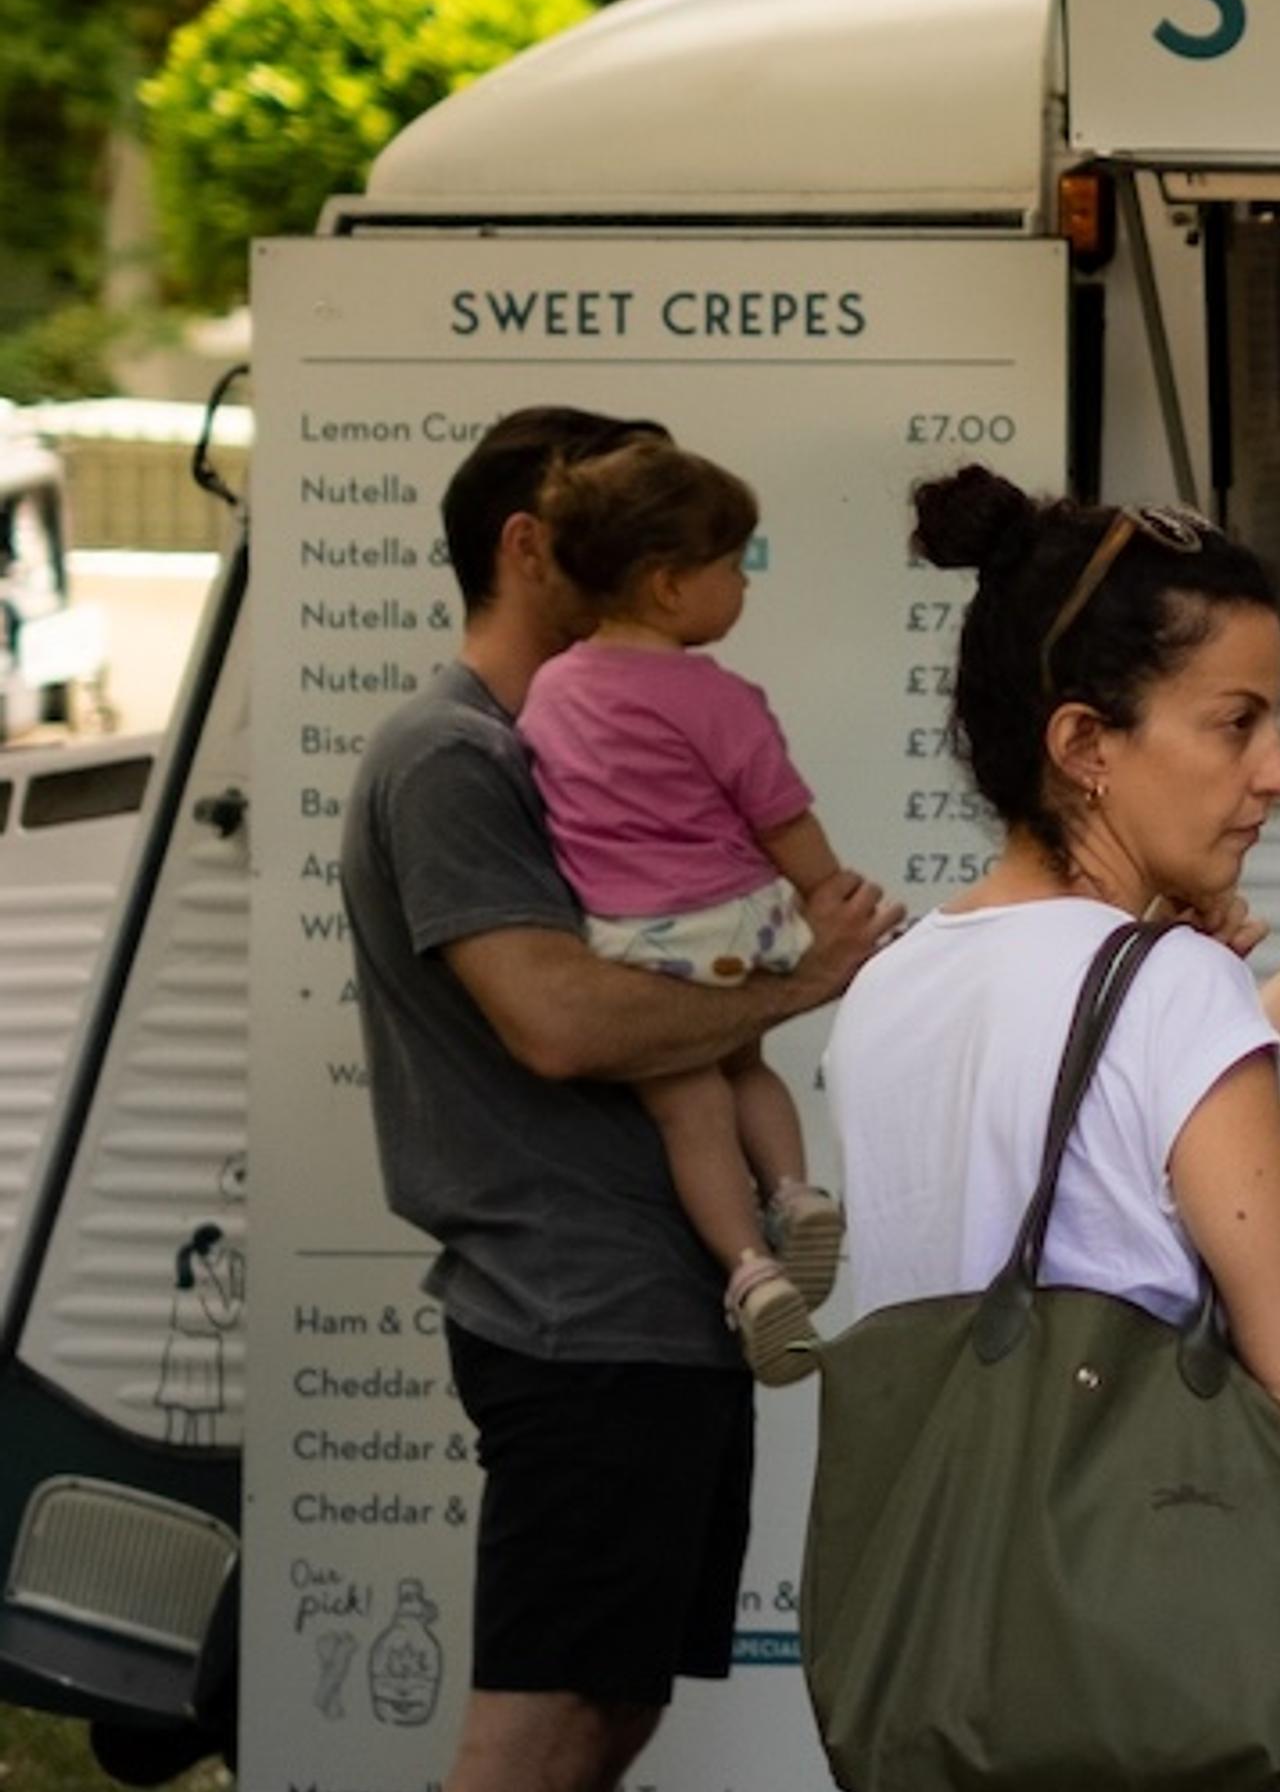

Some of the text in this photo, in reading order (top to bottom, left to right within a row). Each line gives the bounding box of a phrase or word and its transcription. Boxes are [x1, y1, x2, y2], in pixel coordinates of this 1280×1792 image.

[452, 291, 868, 337] SWEET CREPES
[301, 411, 499, 443] Lemon Cur
[906, 414, 1016, 444] £7.00
[301, 473, 418, 504] Nutella
[301, 537, 418, 568] Nutella
[301, 601, 452, 631] Nutella &
[301, 665, 418, 694] Nutella
[294, 1306, 368, 1335] Ham
[378, 1305, 401, 1335] &
[293, 1367, 436, 1398] Cheddar
[293, 1430, 468, 1462] Cheddar &
[292, 1493, 467, 1526] Cheddar &
[291, 1559, 342, 1589] Our
[294, 1583, 374, 1636] pick!
